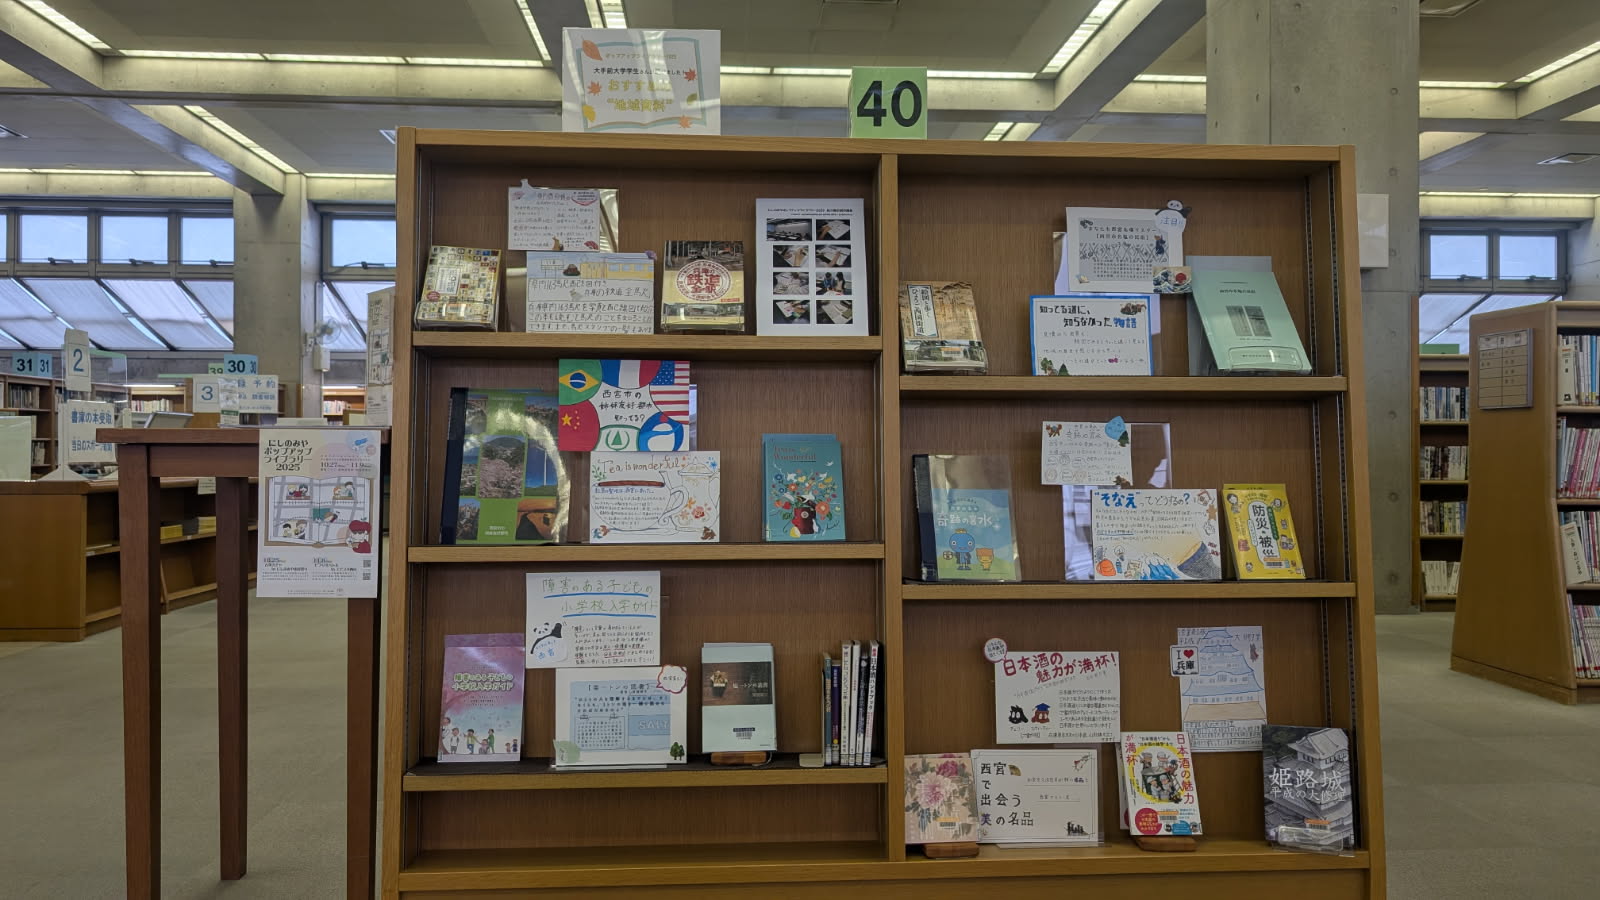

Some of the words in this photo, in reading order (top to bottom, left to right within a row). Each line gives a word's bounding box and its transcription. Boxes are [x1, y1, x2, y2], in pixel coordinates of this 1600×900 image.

[857, 80, 923, 128] 40
[16, 358, 33, 373] 31
[39, 359, 50, 373] 31
[73, 348, 84, 373] 2
[227, 359, 246, 374] 30
[201, 385, 214, 401] 3
[602, 389, 642, 399] 西宮市の
[268, 439, 309, 447] にしのみや
[263, 447, 313, 456] ポップアップ
[263, 455, 313, 464] ライブラリー
[275, 463, 301, 472] 2025
[1003, 652, 1064, 677] 日本酒の
[1036, 653, 1118, 684] 魅力が満杯!
[980, 761, 1007, 776] 西宮
[1176, 733, 1195, 805] 日本酒の魅力
[982, 780, 991, 790] で
[1268, 767, 1345, 792] 姫路城
[980, 793, 1021, 807] 出会う
[1271, 786, 1346, 802] 平成の大修理
[980, 810, 1034, 827] 美の名品
